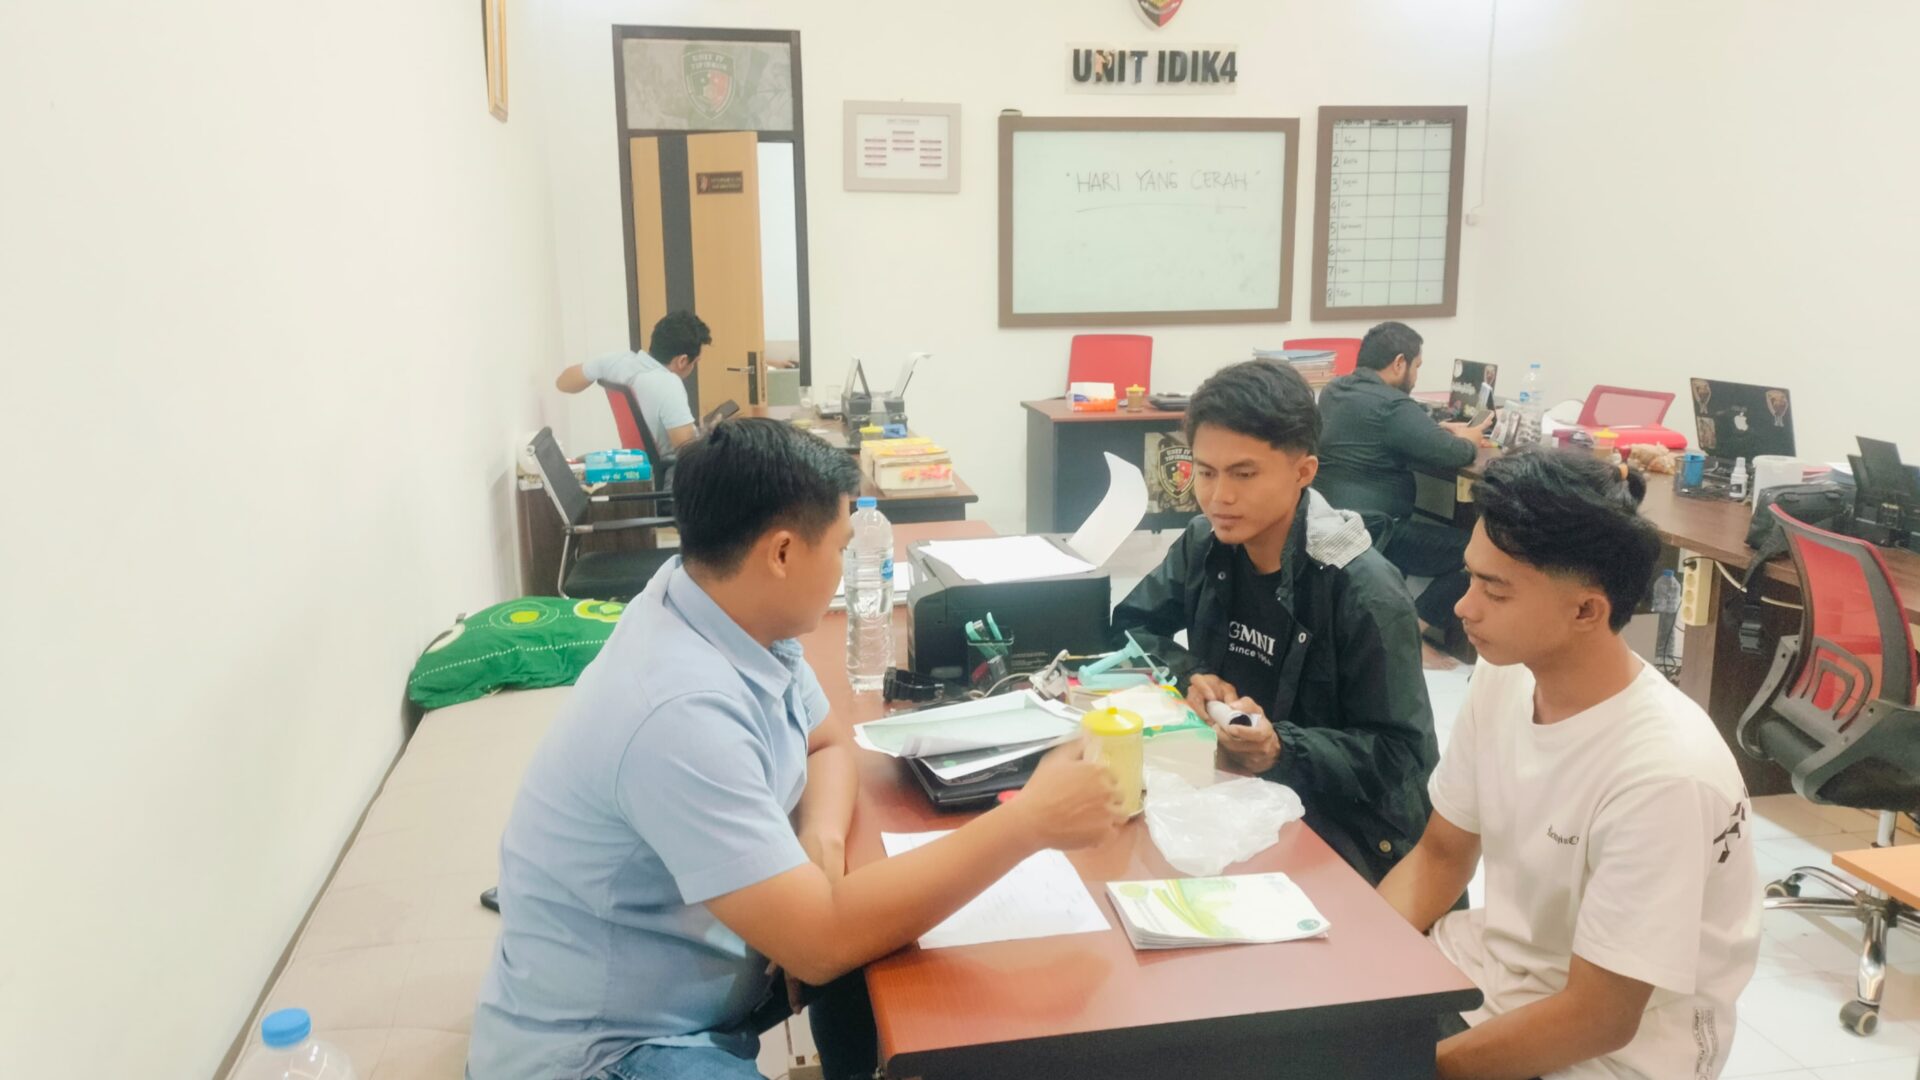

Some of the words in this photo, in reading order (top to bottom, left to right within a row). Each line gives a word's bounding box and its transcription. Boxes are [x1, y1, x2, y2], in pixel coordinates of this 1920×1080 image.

[1072, 49, 1147, 84] UNIT
[1157, 49, 1238, 84] IDIK4
[1332, 155, 1340, 167] 2
[1135, 169, 1179, 193] YANG
[1331, 178, 1340, 192] 3
[1329, 221, 1337, 234] 5
[1328, 244, 1336, 256] 6
[1328, 265, 1335, 276] 7
[1228, 620, 1276, 656] GMNI
[1228, 642, 1257, 657] Since
